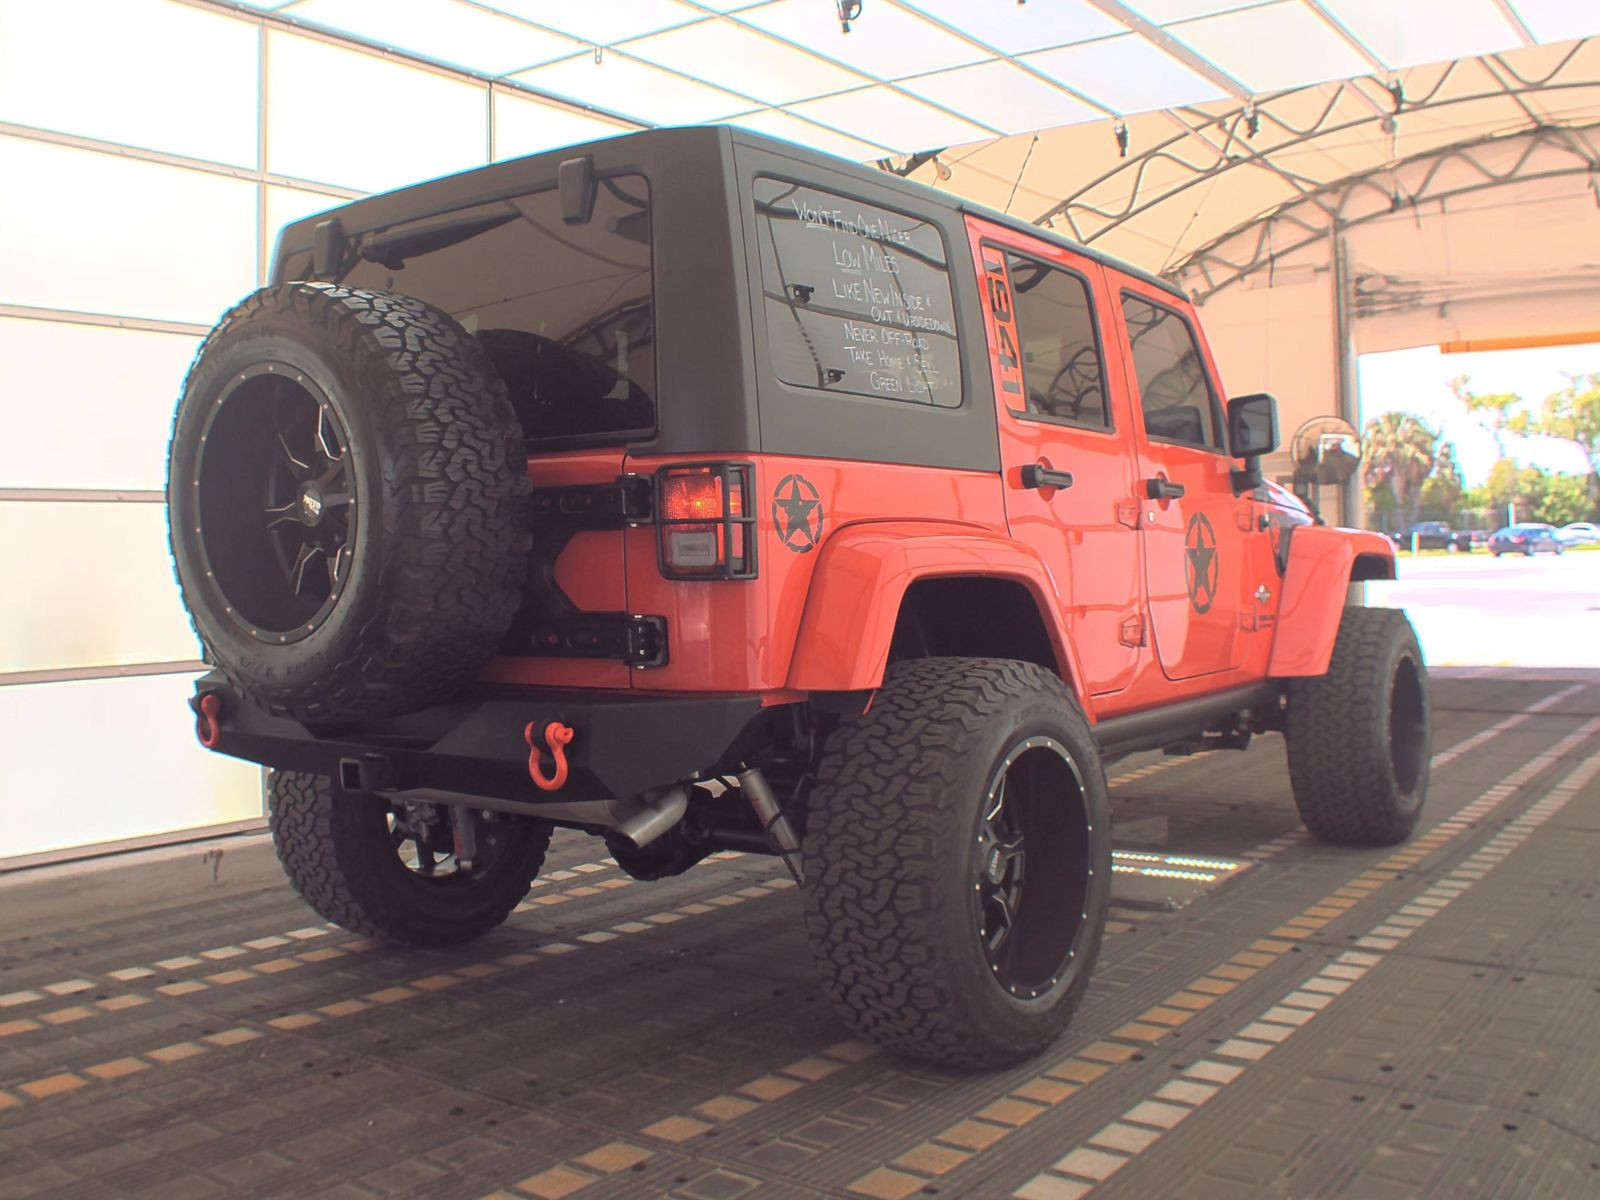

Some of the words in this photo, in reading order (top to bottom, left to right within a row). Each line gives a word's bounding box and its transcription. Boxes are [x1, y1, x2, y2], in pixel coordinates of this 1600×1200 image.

[833, 241, 862, 268] LOW
[862, 245, 900, 273] MILES
[832, 277, 863, 303] LIKE
[863, 278, 889, 305] NEW
[870, 306, 893, 324] OUT
[983, 258, 1022, 394] 1941
[843, 322, 877, 345] NEVER
[843, 346, 875, 365] TAKE
[870, 371, 903, 393] GREEN
